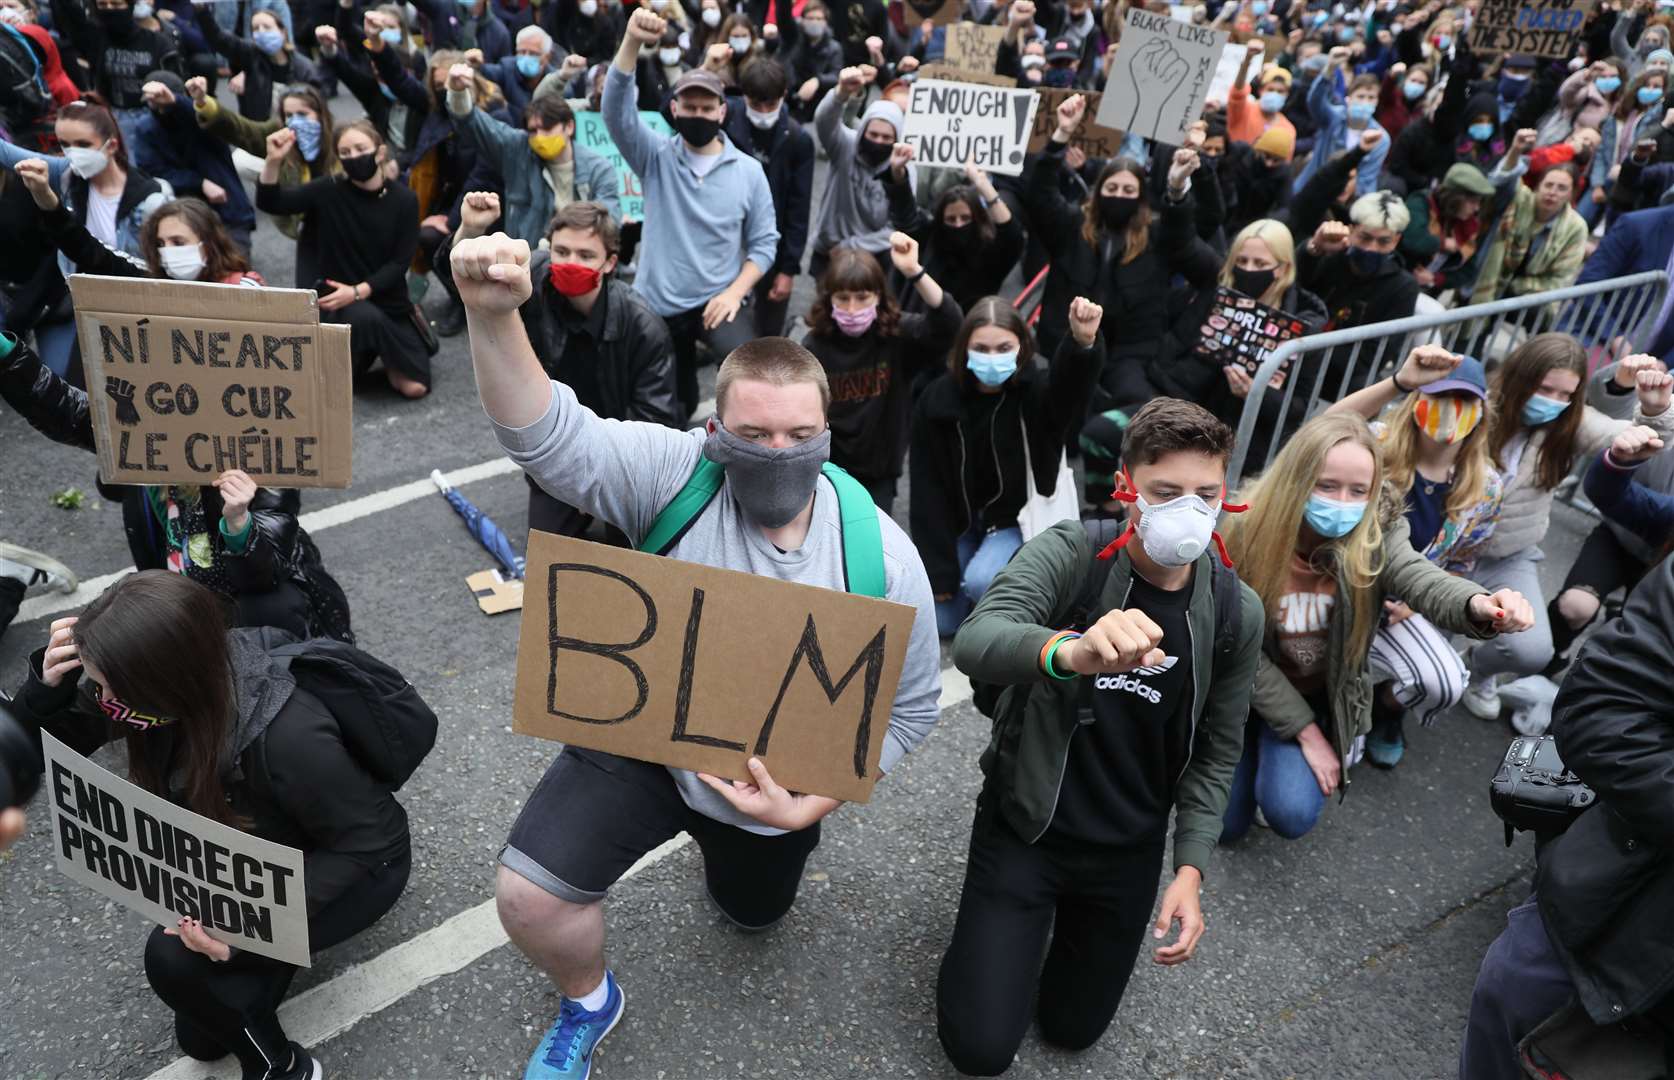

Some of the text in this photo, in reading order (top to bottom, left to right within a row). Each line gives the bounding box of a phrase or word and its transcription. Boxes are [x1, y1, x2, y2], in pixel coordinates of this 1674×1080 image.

[1131, 11, 1216, 47] BLACK LIVES
[1517, 8, 1583, 30] FUCKED
[911, 87, 1008, 118] ENOUGH
[1178, 57, 1211, 132] MATTER
[948, 118, 962, 132] IS
[100, 318, 312, 371] NÍ NEART
[145, 381, 296, 420] GO CUR
[118, 431, 169, 472] LE
[547, 562, 887, 779] BLM
[1095, 674, 1162, 704] adidas
[51, 759, 294, 907] END DIRECT
[58, 813, 273, 944] PROVISION
